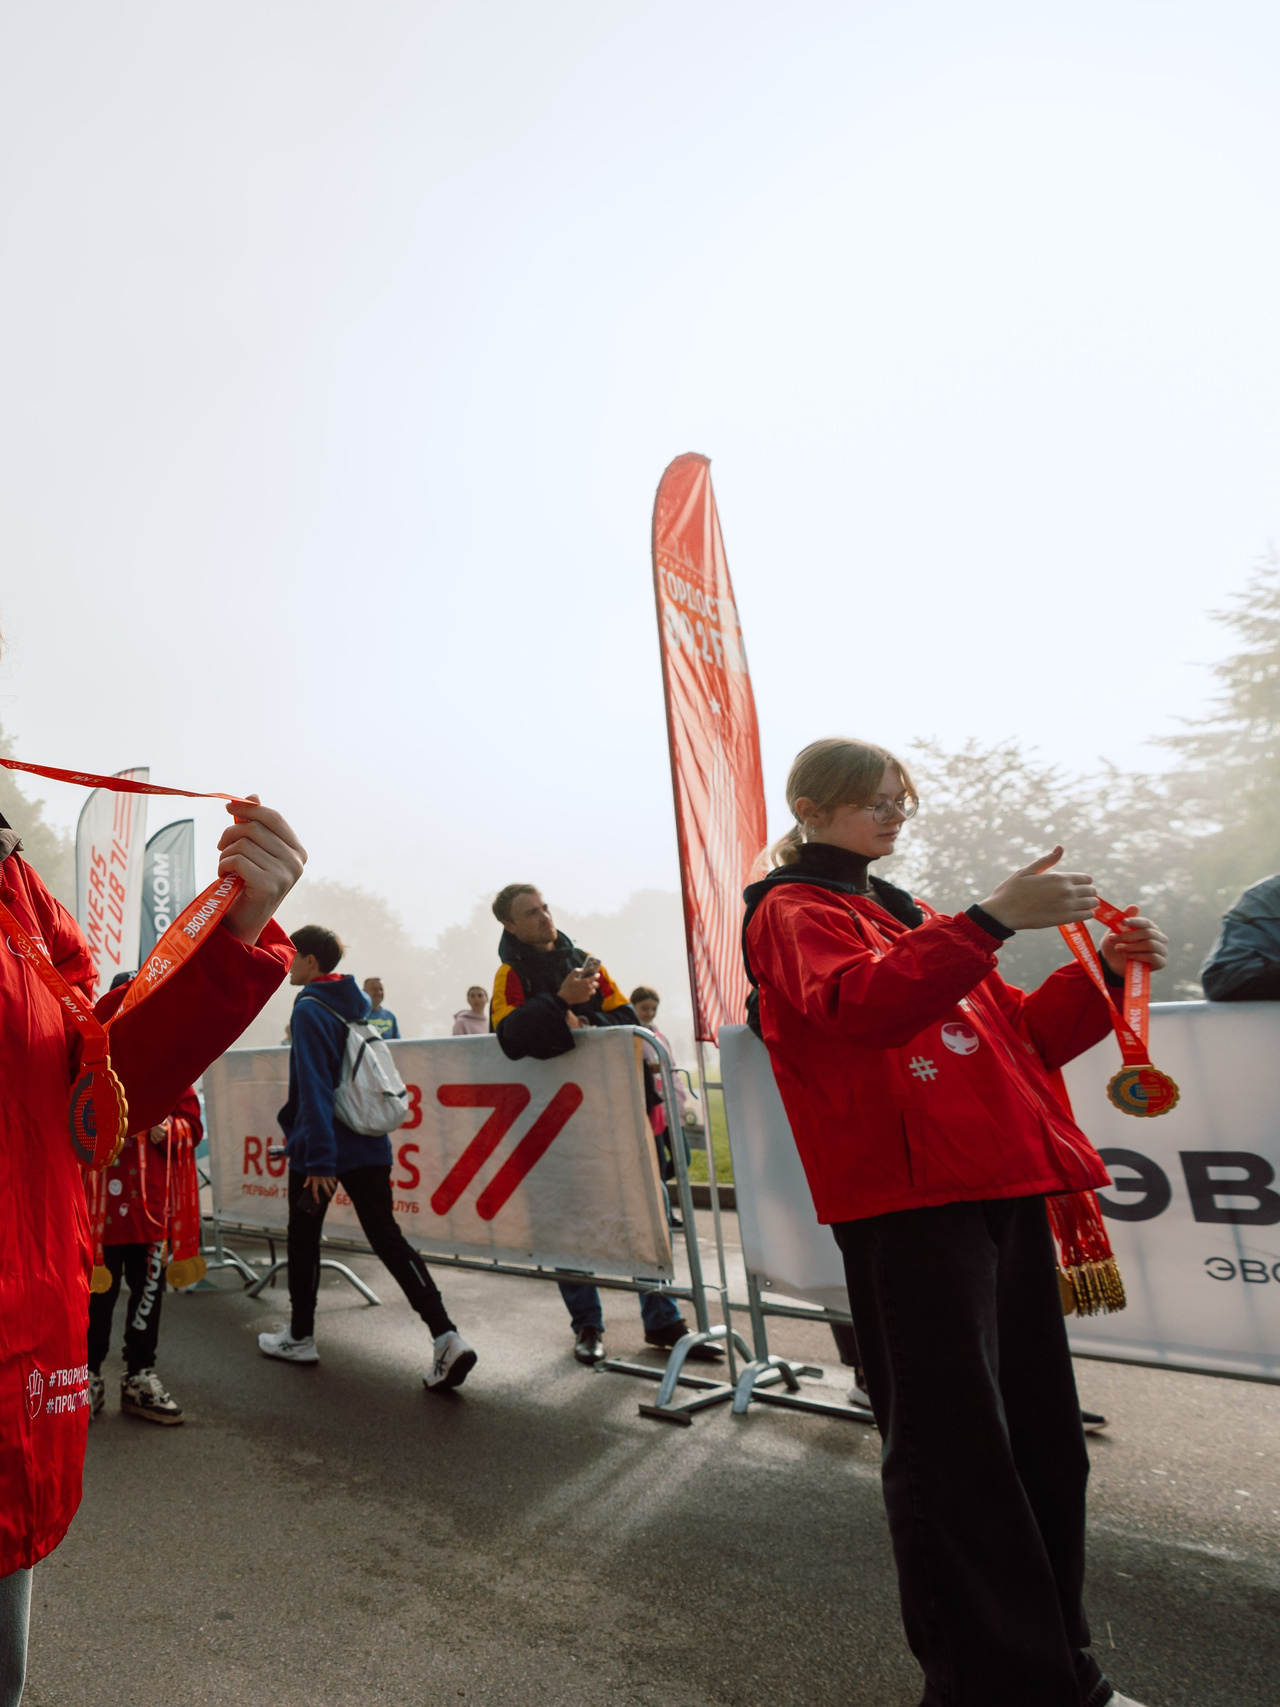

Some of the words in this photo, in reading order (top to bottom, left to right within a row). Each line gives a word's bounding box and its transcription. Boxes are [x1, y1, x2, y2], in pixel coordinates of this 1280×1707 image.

[87, 845, 106, 985] NNERS
[153, 852, 170, 942] ОКОМ
[104, 871, 125, 966] CLUB
[183, 898, 222, 939] ЭВОКОМ
[61, 996, 80, 1014] КМ
[77, 1011, 88, 1023] 5
[242, 1183, 279, 1198] ПЕРВЫЙ
